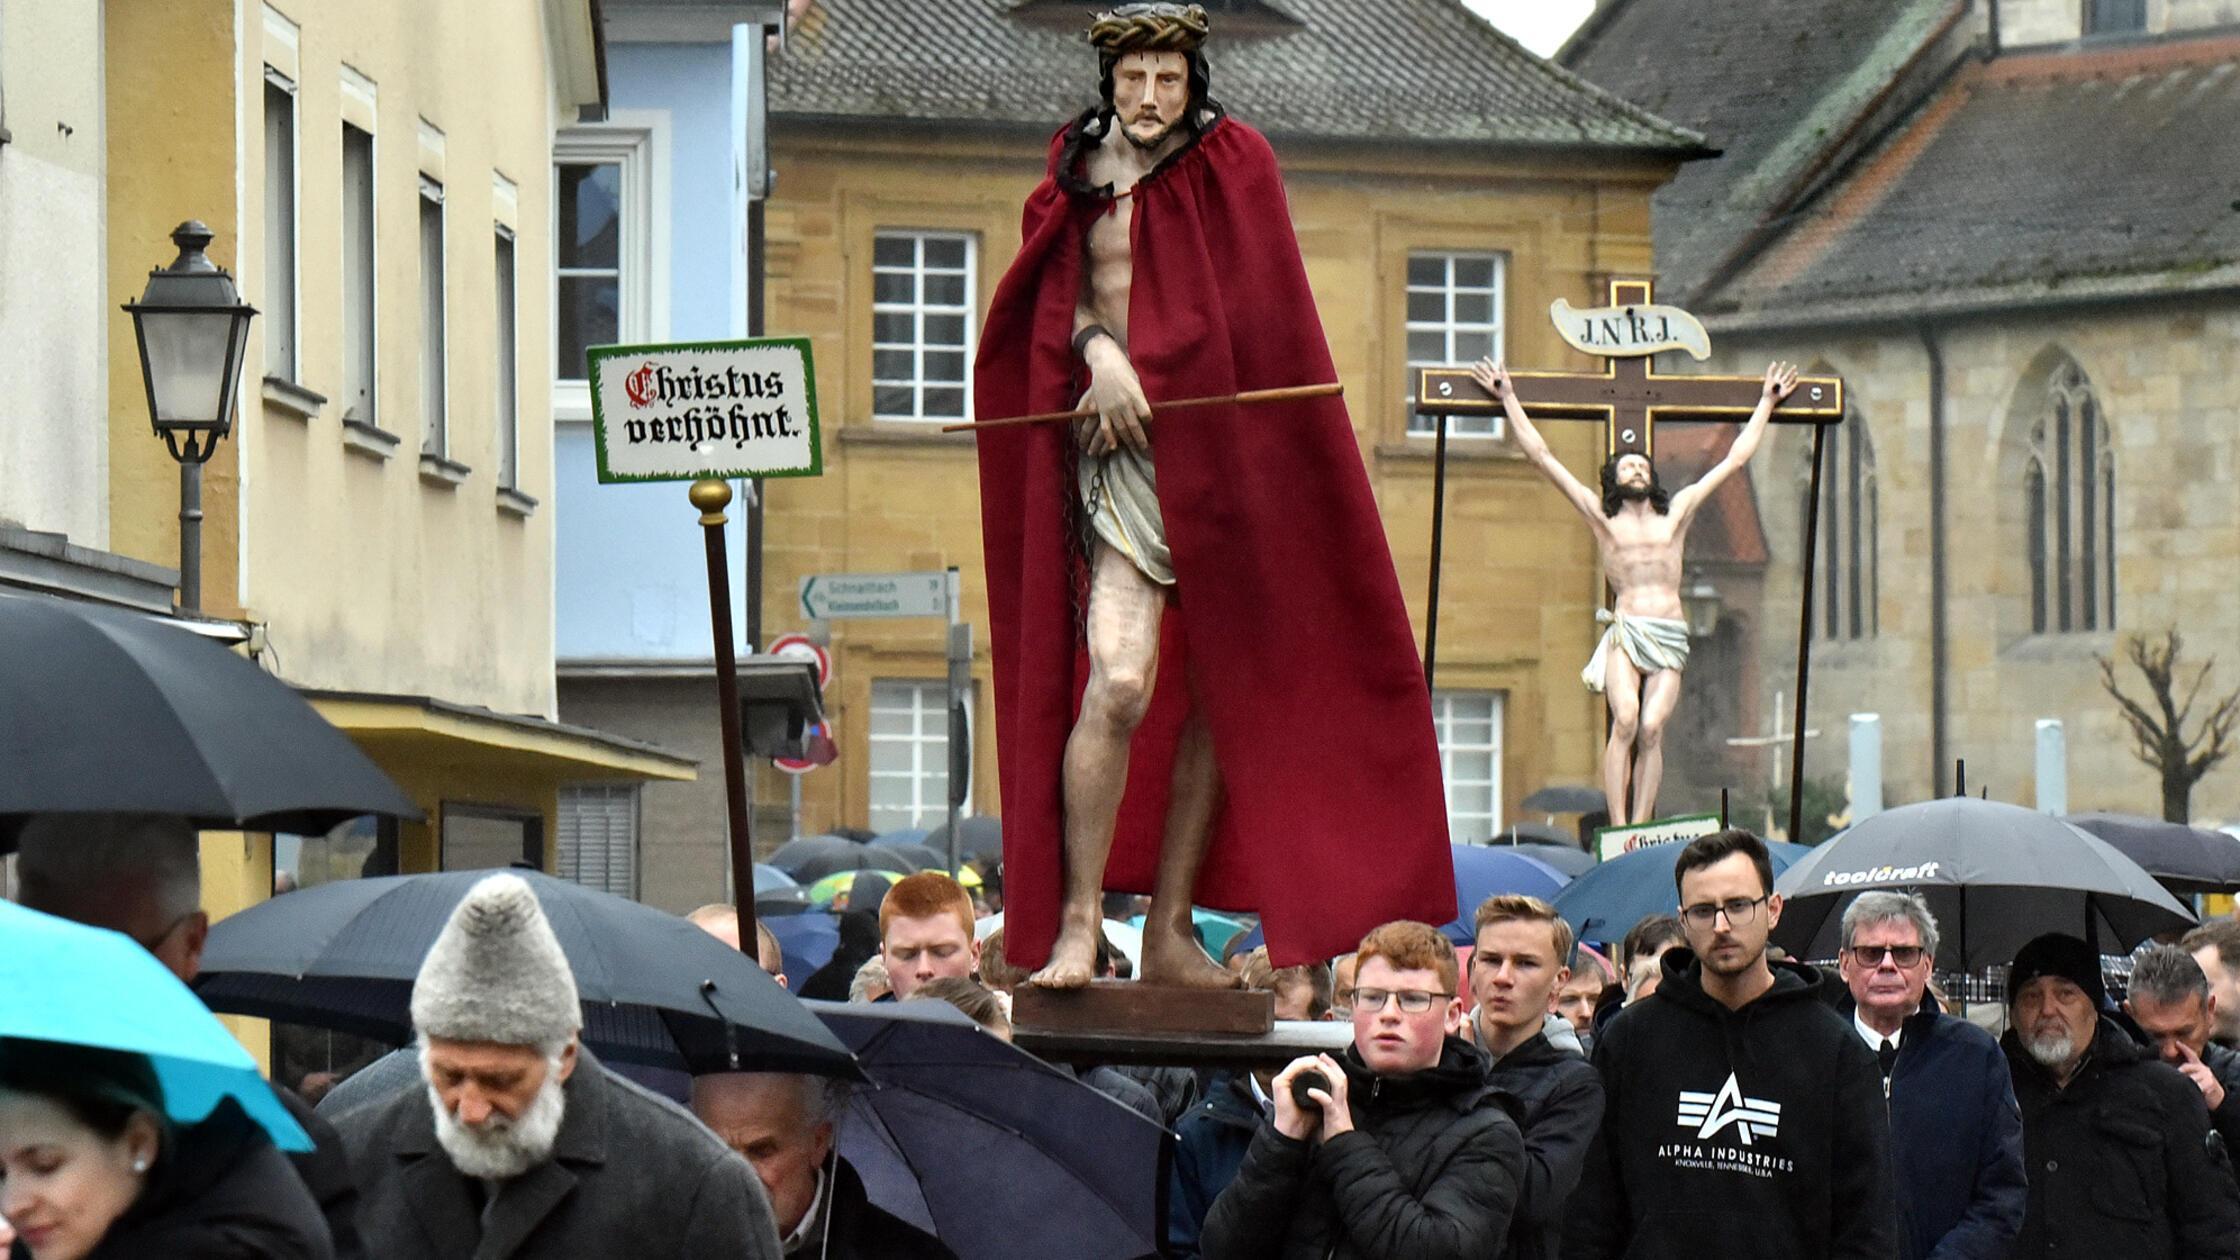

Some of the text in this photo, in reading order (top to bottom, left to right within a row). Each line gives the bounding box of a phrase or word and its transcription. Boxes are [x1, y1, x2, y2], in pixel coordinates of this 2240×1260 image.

[625, 361, 784, 409] Christus
[624, 403, 801, 452] verhöhnt.
[1824, 861, 1939, 886] toolcraft
[1658, 1144, 1794, 1172] ALPHA INDUSTRIES
